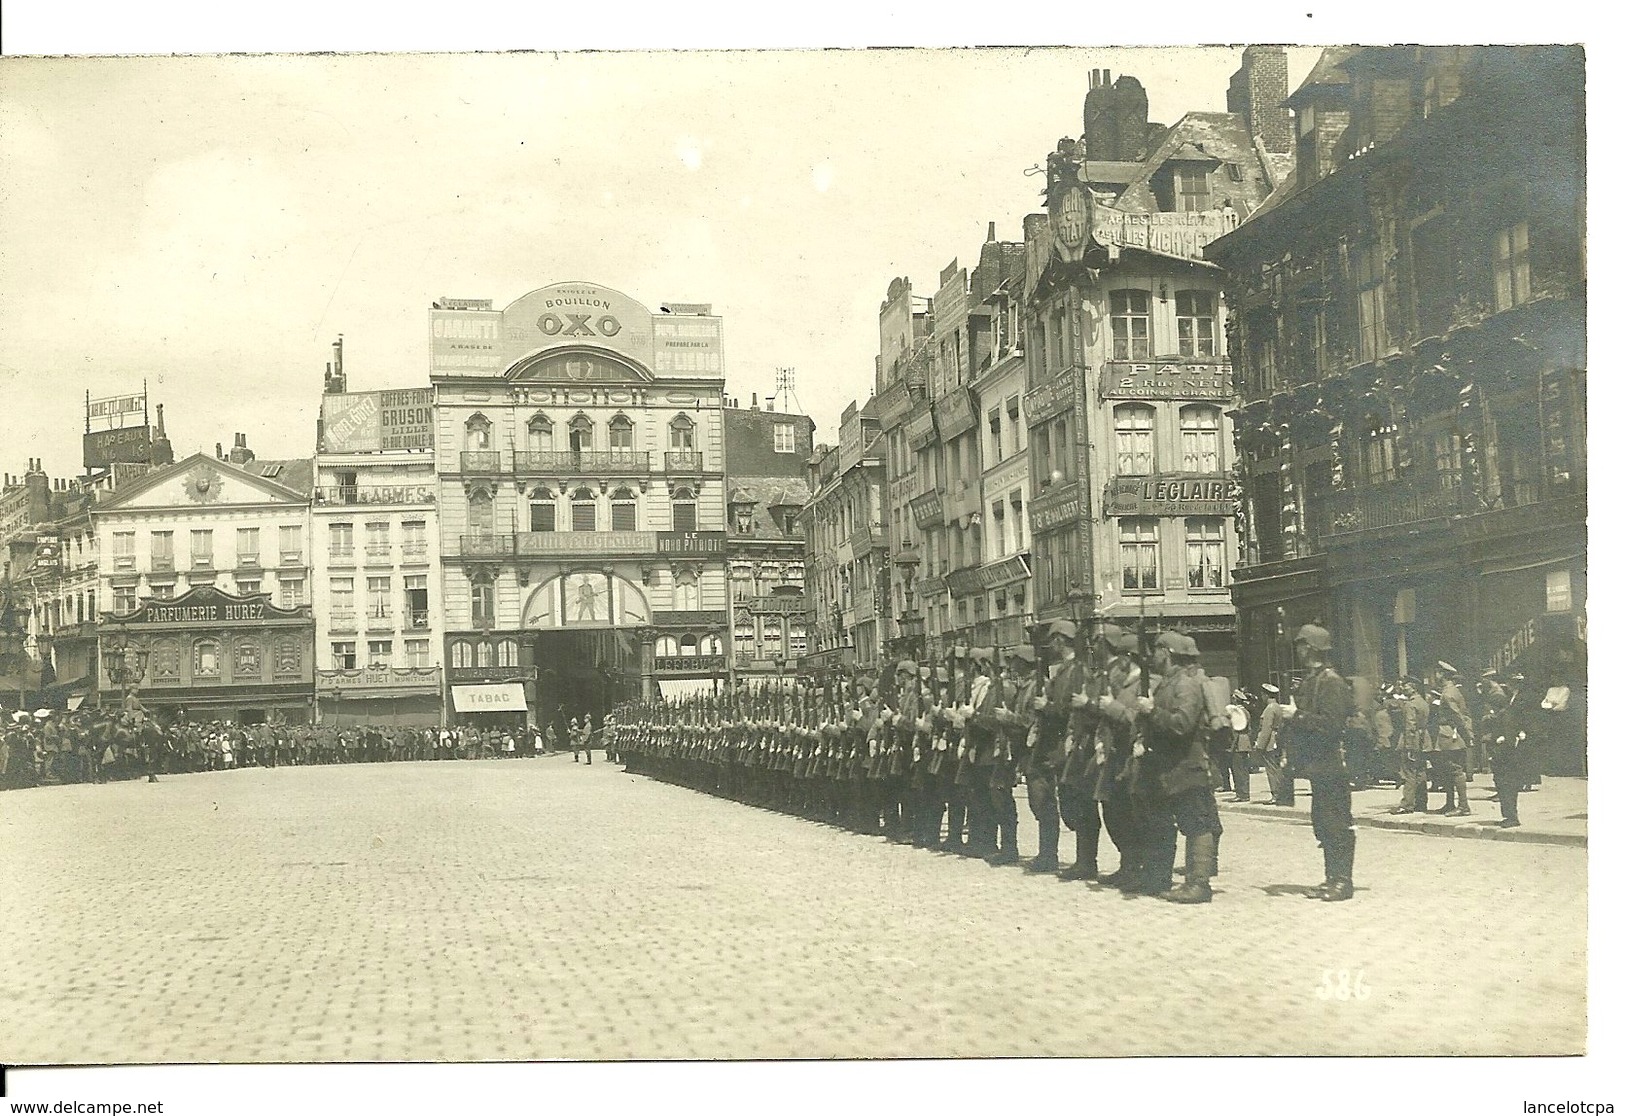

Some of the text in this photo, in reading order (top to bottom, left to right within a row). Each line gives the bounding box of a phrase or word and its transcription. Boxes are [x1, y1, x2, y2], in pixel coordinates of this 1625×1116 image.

[545, 298, 611, 310] BOUILLON
[536, 313, 622, 338] OXO
[1109, 388, 1126, 396] AU
[1129, 388, 1158, 396] COIN
[382, 407, 433, 427] GRUSON
[391, 425, 428, 435] LILLE
[684, 538, 724, 552] PATRIOTE
[147, 604, 265, 622] PARFUMERIE HUREZ
[366, 673, 390, 684] HUET
[394, 676, 436, 684] MUNITIONS
[469, 694, 510, 703] TABAC
